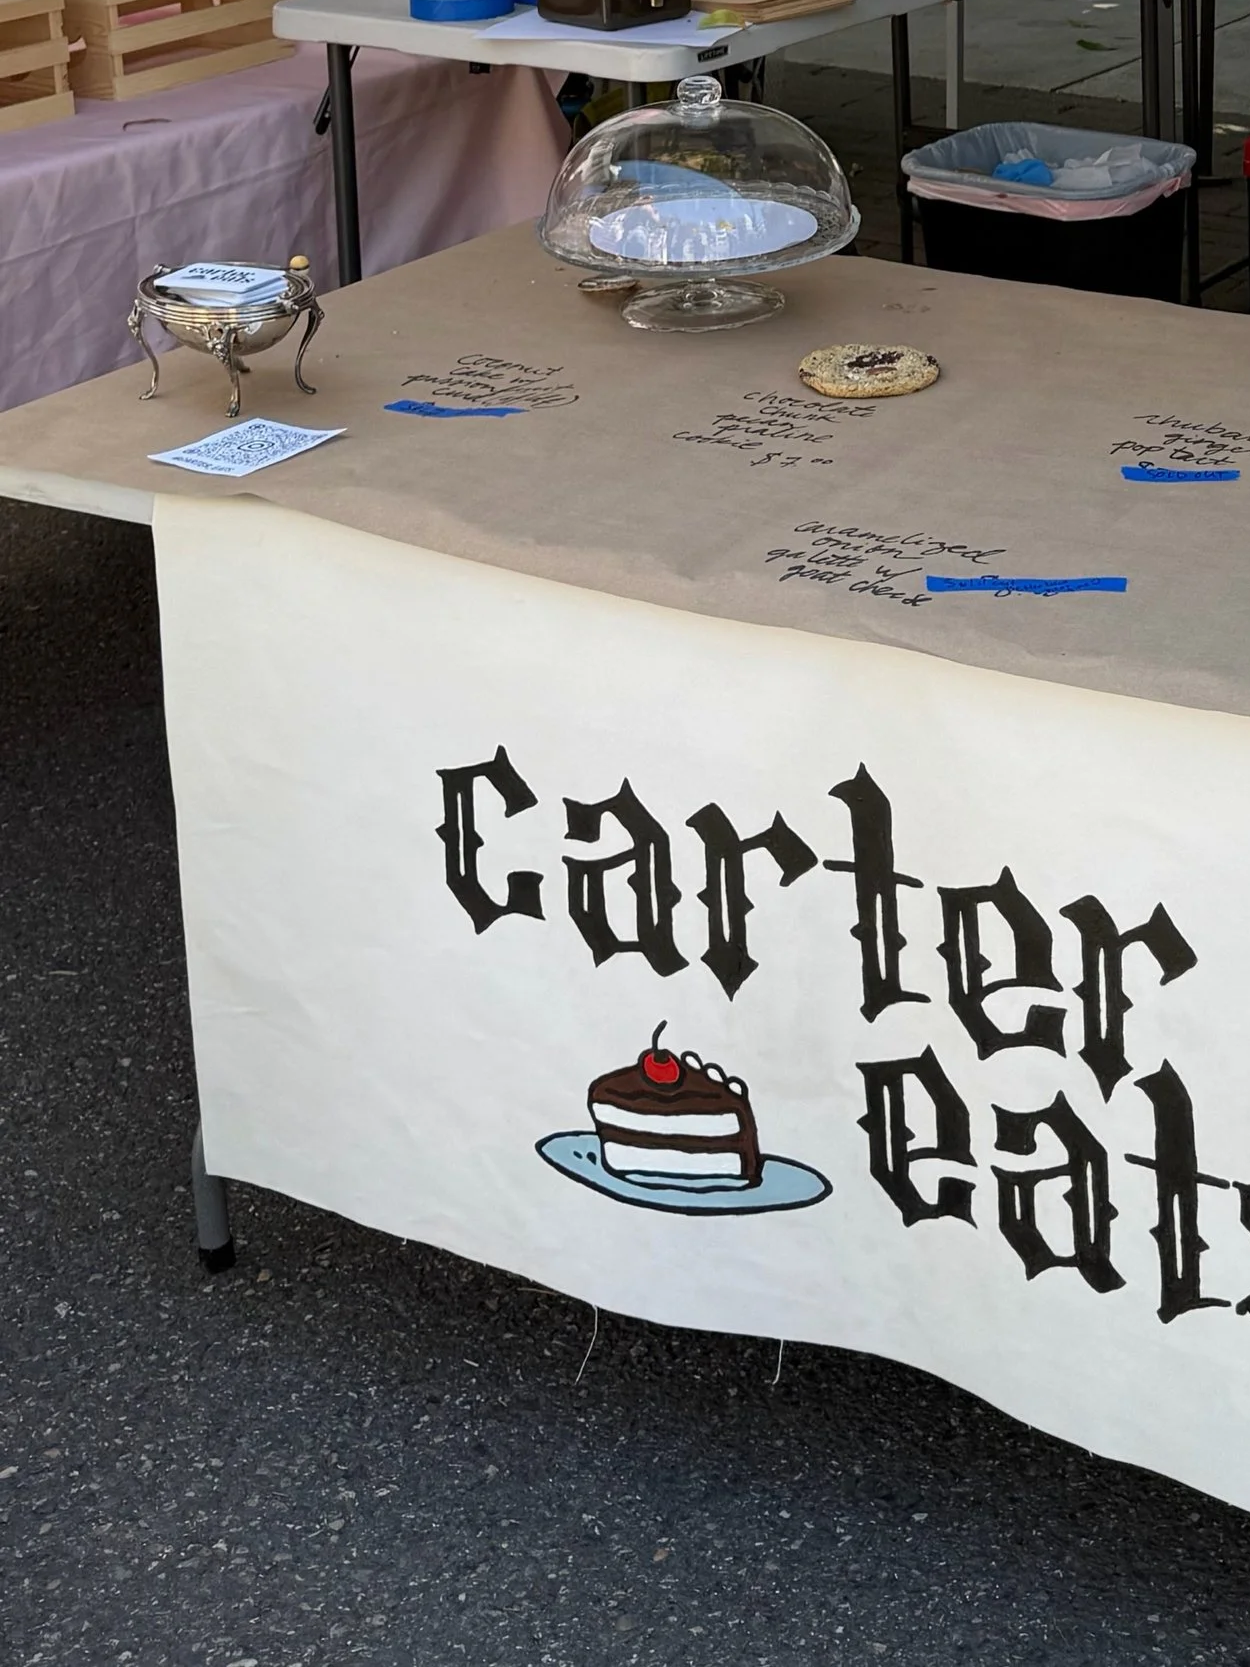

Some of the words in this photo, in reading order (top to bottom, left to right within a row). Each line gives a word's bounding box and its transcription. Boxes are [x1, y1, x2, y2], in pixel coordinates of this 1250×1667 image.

[743, 391, 877, 418] chocolate
[672, 431, 764, 450] cookie
[713, 423, 834, 444] praline
[1109, 440, 1166, 456] pop
[1168, 446, 1236, 466] tart
[794, 521, 1006, 564] caramelized
[812, 534, 924, 560] onion
[778, 563, 852, 582] goat
[848, 578, 933, 607] cheese
[435, 744, 1199, 1103] carter
